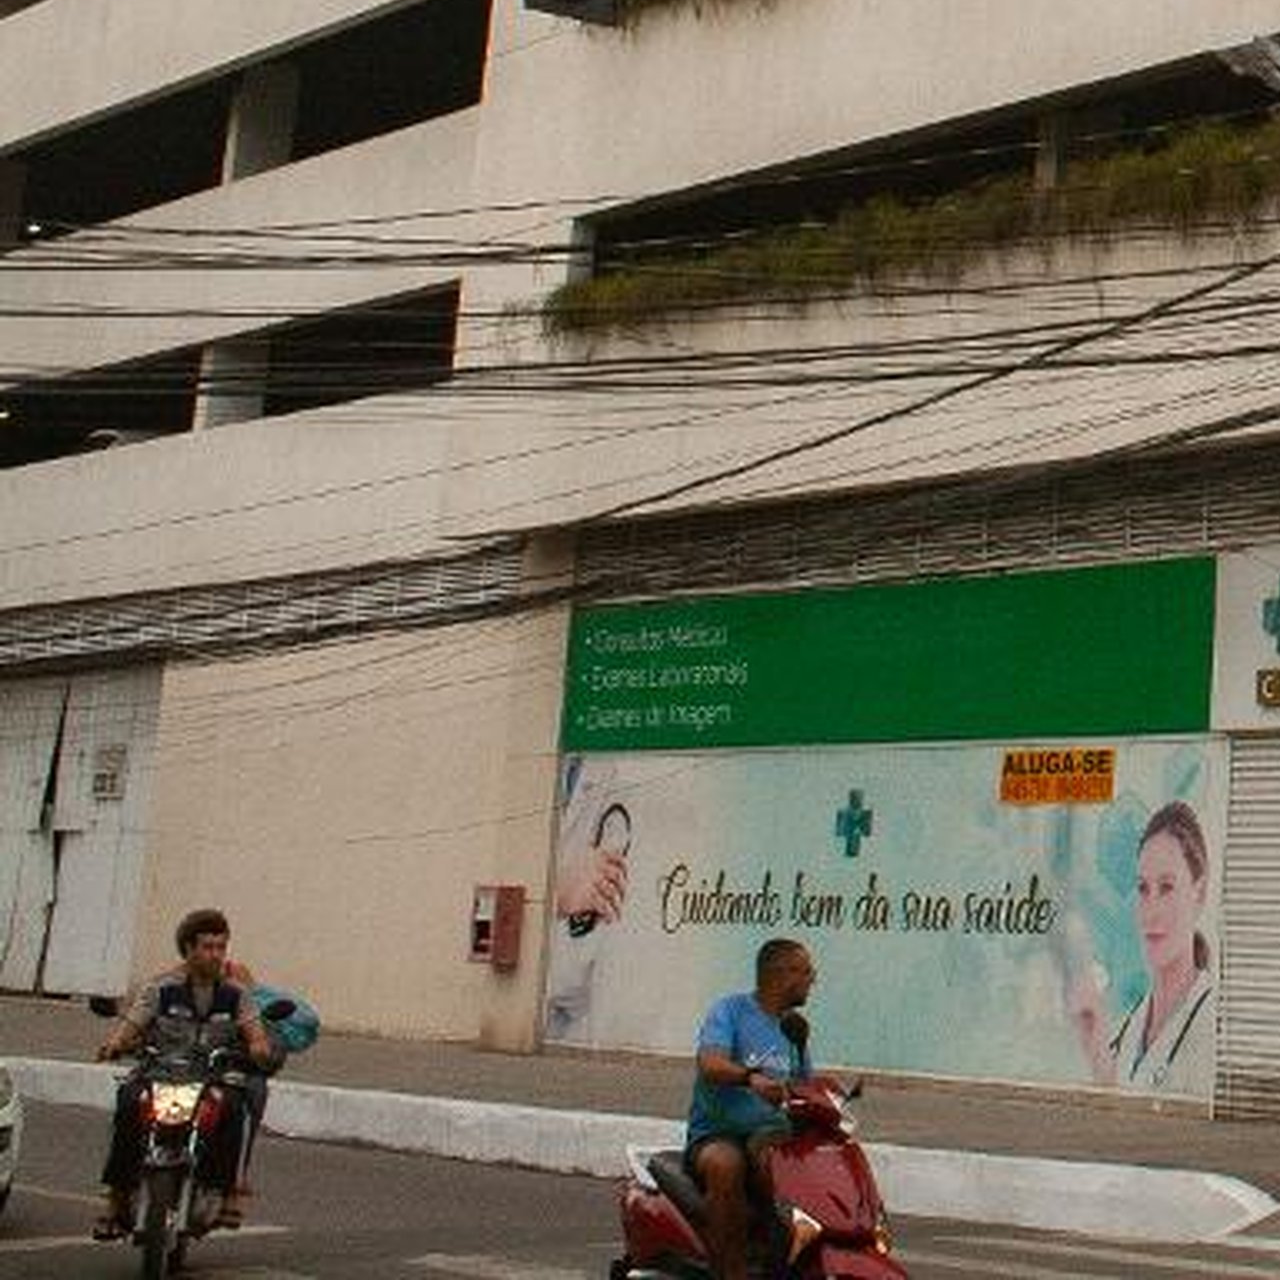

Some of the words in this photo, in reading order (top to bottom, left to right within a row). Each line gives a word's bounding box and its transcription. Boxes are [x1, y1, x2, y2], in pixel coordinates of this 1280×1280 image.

[1003, 748, 1112, 776] ALUGA-SE
[661, 863, 782, 934] Cuidando
[790, 870, 844, 929] bem
[856, 871, 891, 933] da
[902, 890, 954, 934] sua
[964, 872, 1056, 935] saúde
